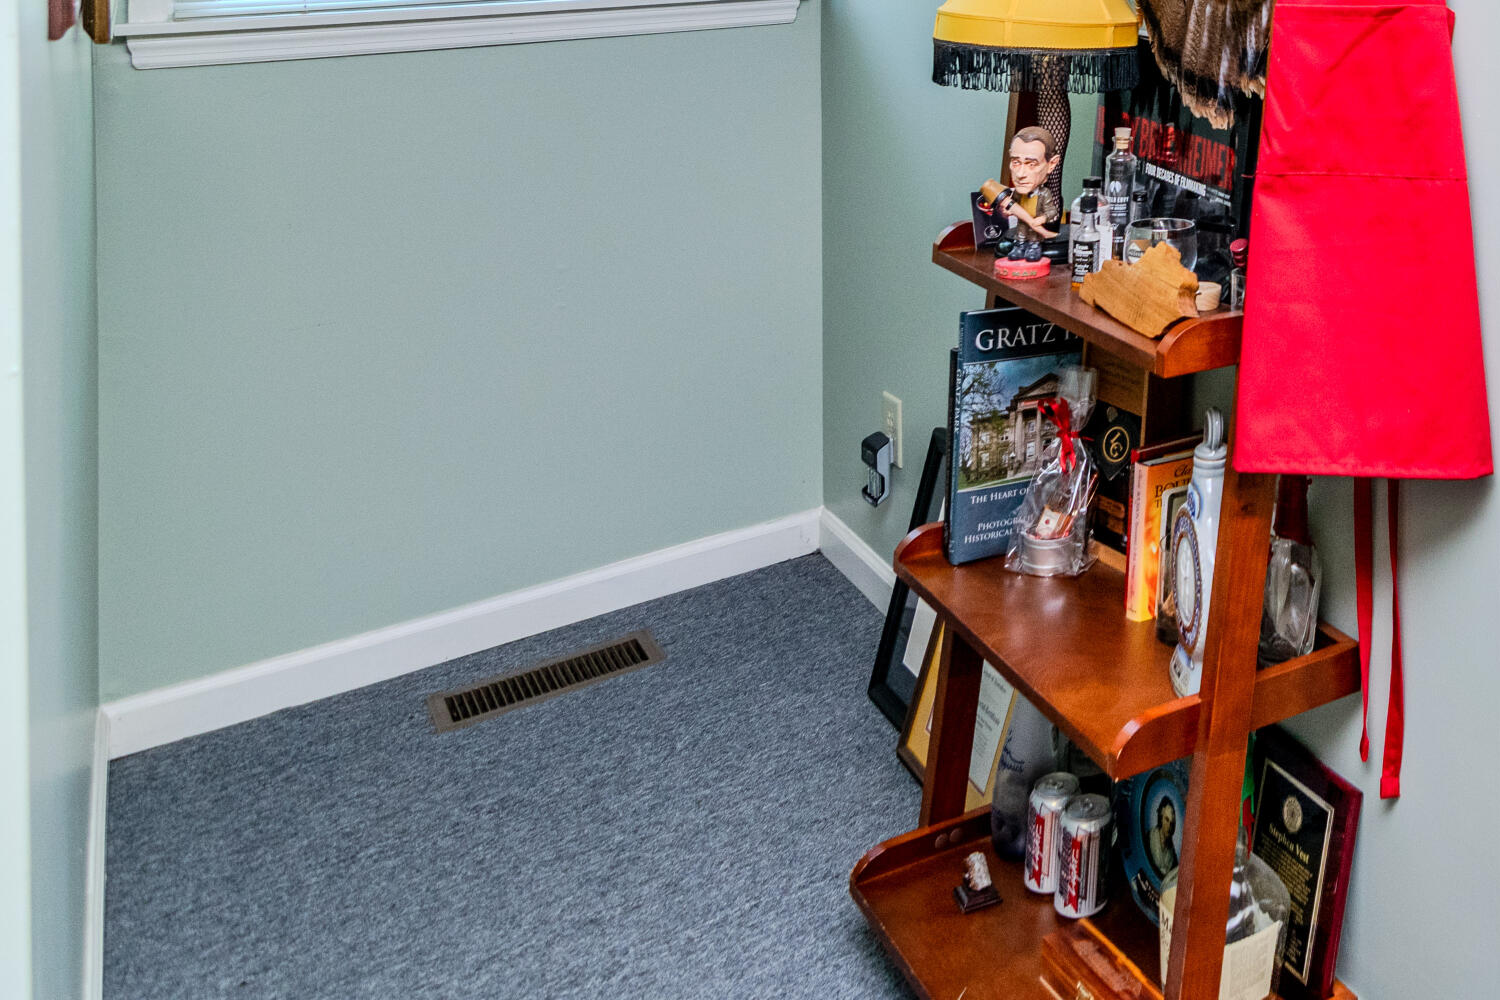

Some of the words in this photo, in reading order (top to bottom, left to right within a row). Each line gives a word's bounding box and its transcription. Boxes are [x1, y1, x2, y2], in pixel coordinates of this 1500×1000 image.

[1145, 161, 1157, 178] FOUR
[1156, 166, 1175, 185] DECADES
[975, 322, 1056, 351] GRATZ
[970, 494, 987, 504] THE
[990, 489, 1018, 502] HEART
[1268, 822, 1295, 851] Stephen
